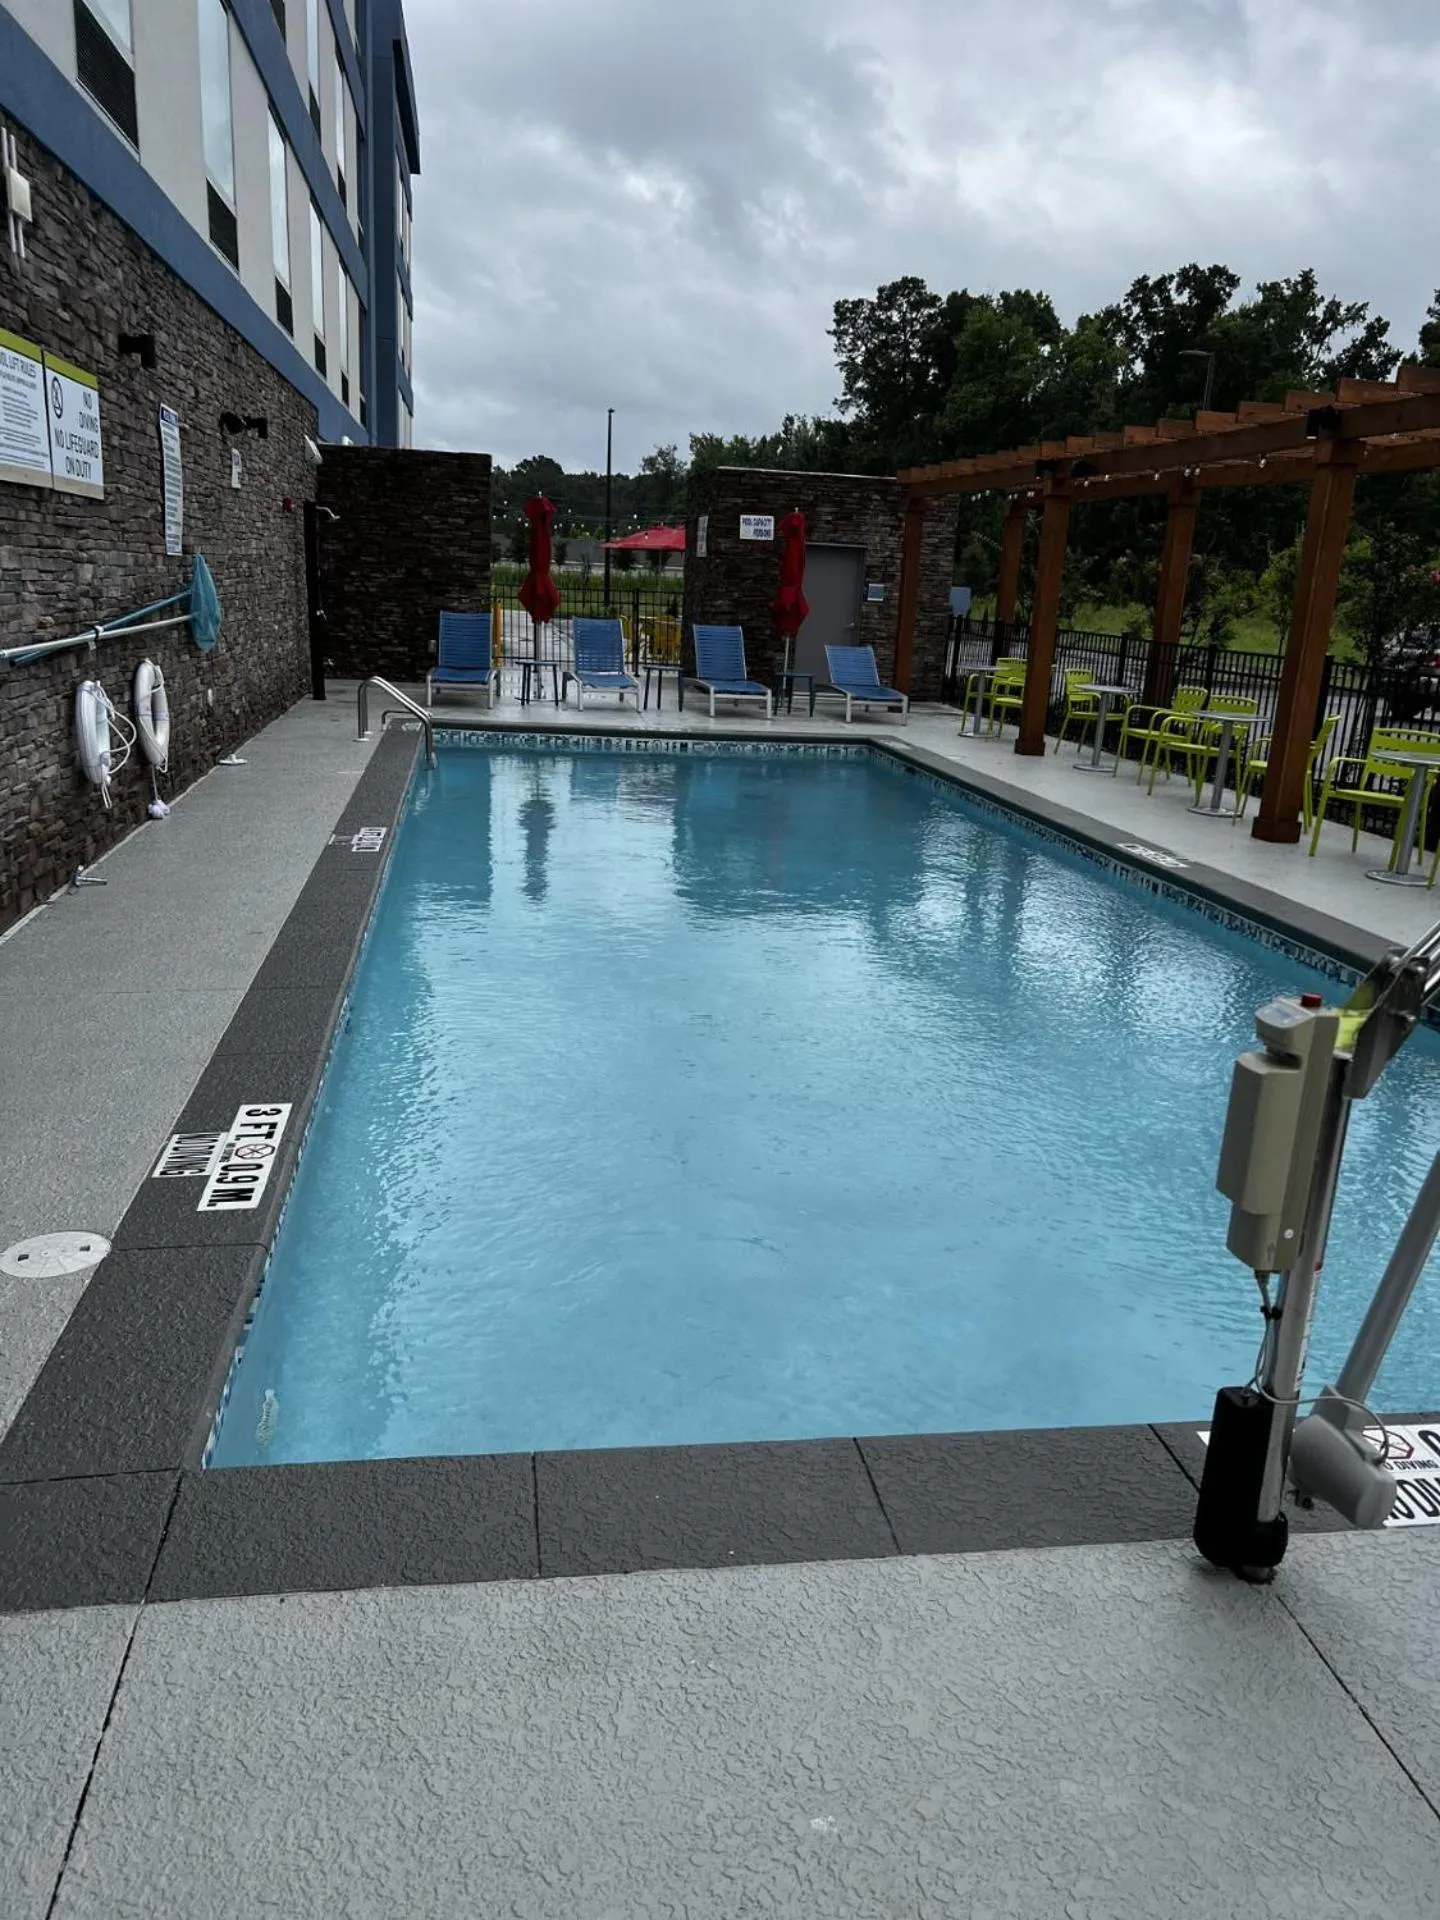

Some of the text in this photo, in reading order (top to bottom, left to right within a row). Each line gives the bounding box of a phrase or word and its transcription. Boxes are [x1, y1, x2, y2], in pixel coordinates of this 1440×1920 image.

[83, 391, 93, 410] NO
[79, 411, 98, 433] DIVING
[55, 427, 65, 448] NO
[65, 431, 99, 459] LIFEGUARD
[66, 455, 91, 480] ON DUTY
[207, 1108, 282, 1207] 3 FT. 0.9 M.
[1393, 1459, 1439, 1470] DIVING
